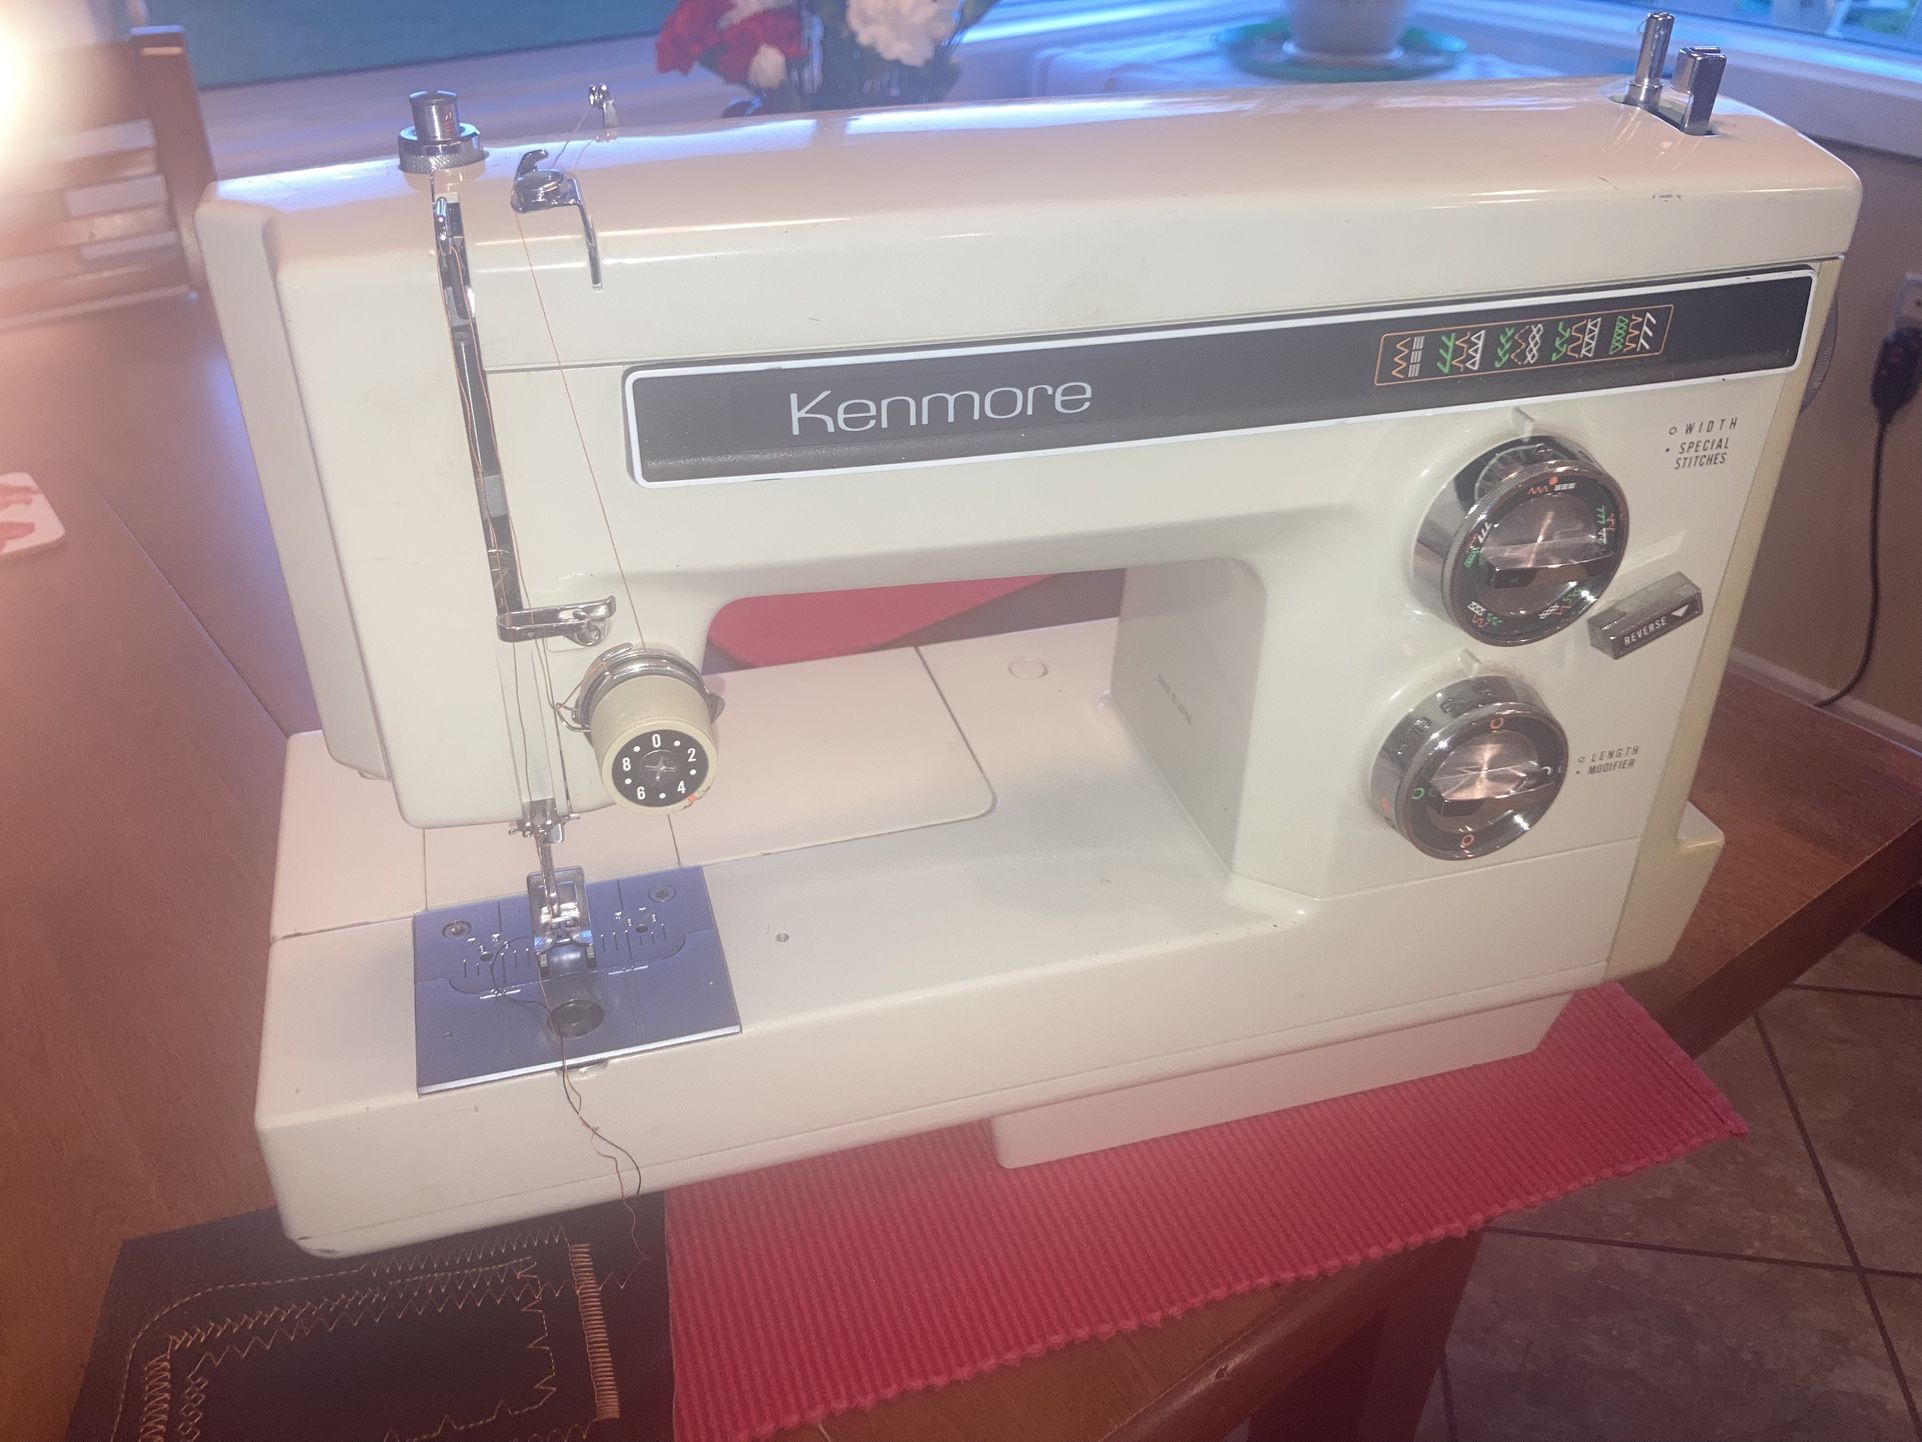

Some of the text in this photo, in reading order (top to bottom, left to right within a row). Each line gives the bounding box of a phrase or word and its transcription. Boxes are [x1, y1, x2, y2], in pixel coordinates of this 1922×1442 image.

[790, 381, 1092, 435] Kenmore
[1685, 417, 1738, 435] WIDTH
[1678, 437, 1729, 455] SPECIAL
[1674, 452, 1728, 470] STITCHES
[1623, 616, 1668, 646] REVERSE
[651, 733, 662, 748] 0
[687, 747, 697, 762] 2
[1591, 745, 1639, 762] LENGTH
[622, 757, 632, 771] 8
[1587, 758, 1636, 775] MODIFIER
[636, 786, 646, 800] 6
[677, 780, 686, 794] 4
